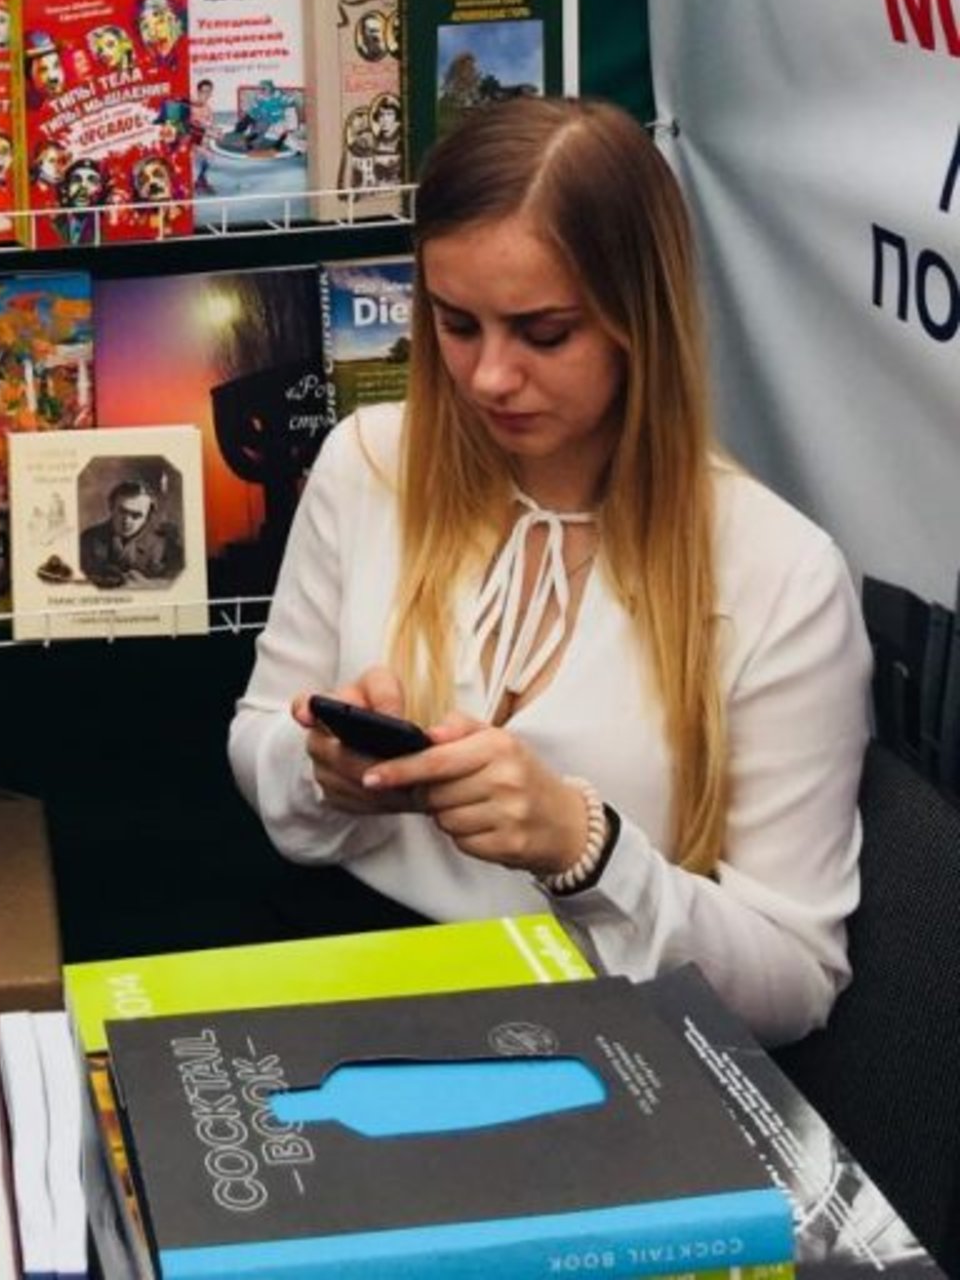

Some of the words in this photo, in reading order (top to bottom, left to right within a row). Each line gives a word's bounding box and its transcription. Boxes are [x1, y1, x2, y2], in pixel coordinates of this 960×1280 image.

[352, 296, 409, 327] Die
[170, 1028, 268, 1212] COCKTAIL
[232, 1054, 316, 1165] BOOK
[548, 1251, 615, 1271] BOOK
[628, 1238, 745, 1264] COCKTAIL
